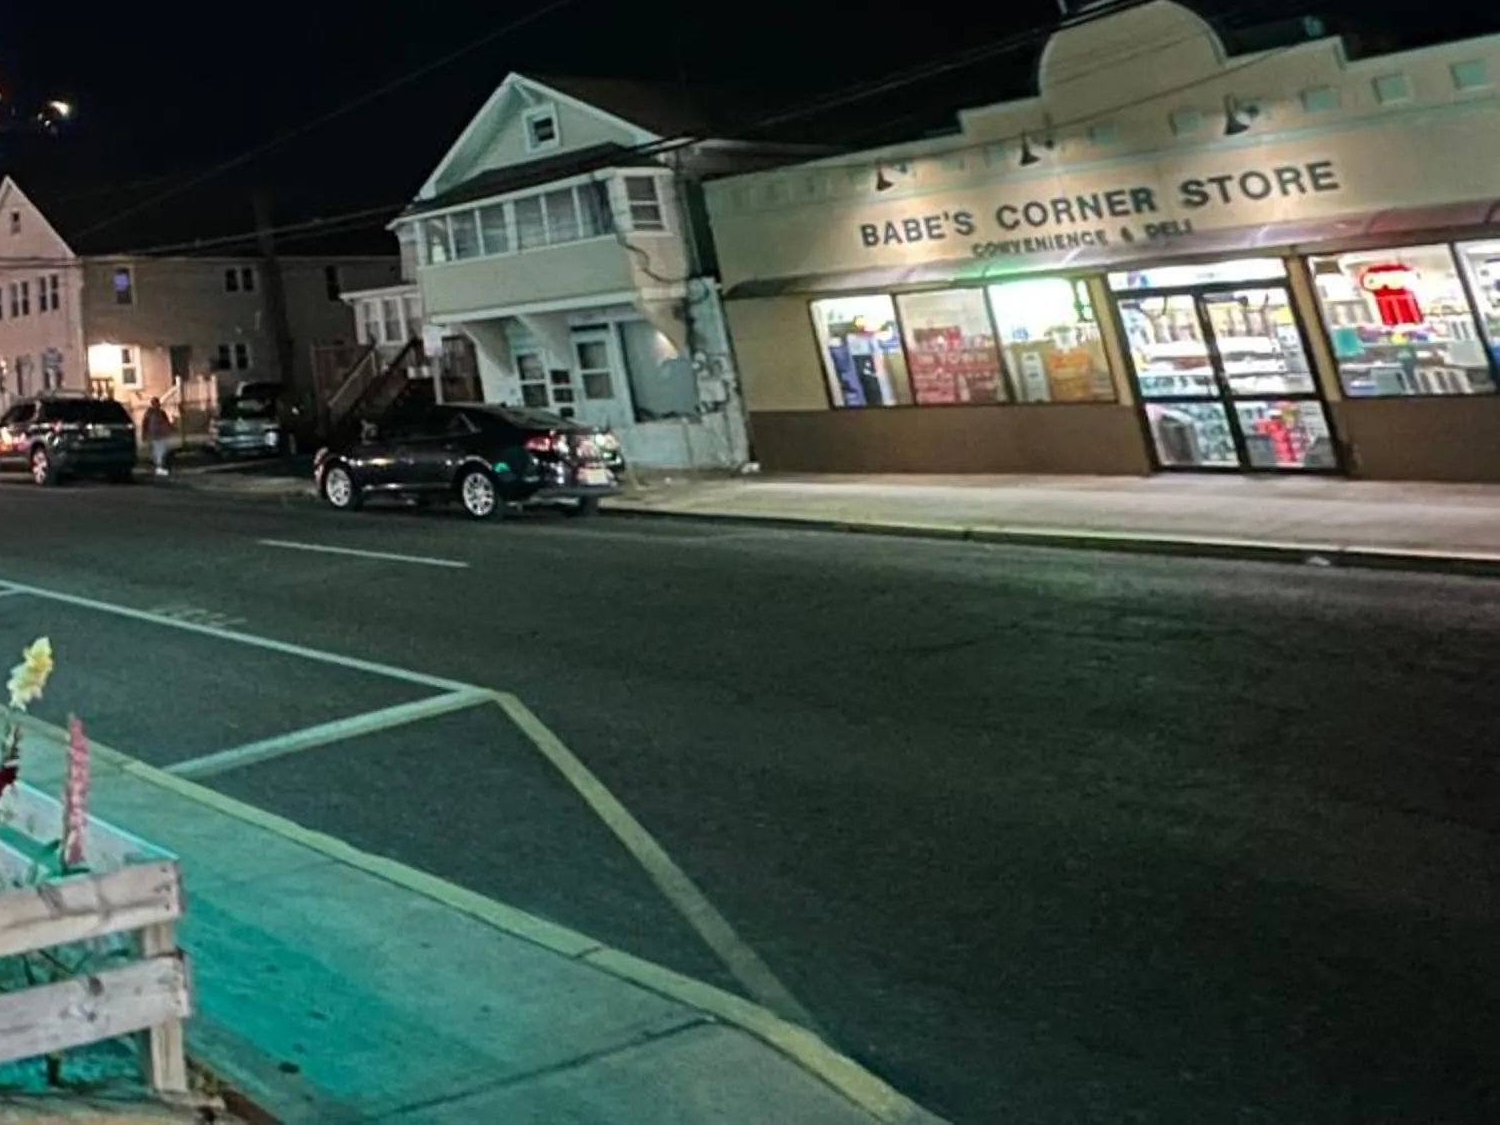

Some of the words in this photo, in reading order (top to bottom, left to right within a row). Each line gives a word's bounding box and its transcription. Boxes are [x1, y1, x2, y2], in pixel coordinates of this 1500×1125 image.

[860, 210, 975, 248] BABE'S
[995, 185, 1156, 231] CORNER
[1180, 160, 1340, 208] STORE
[972, 229, 1109, 259] CONVENIENCE
[1143, 218, 1194, 240] DELI
